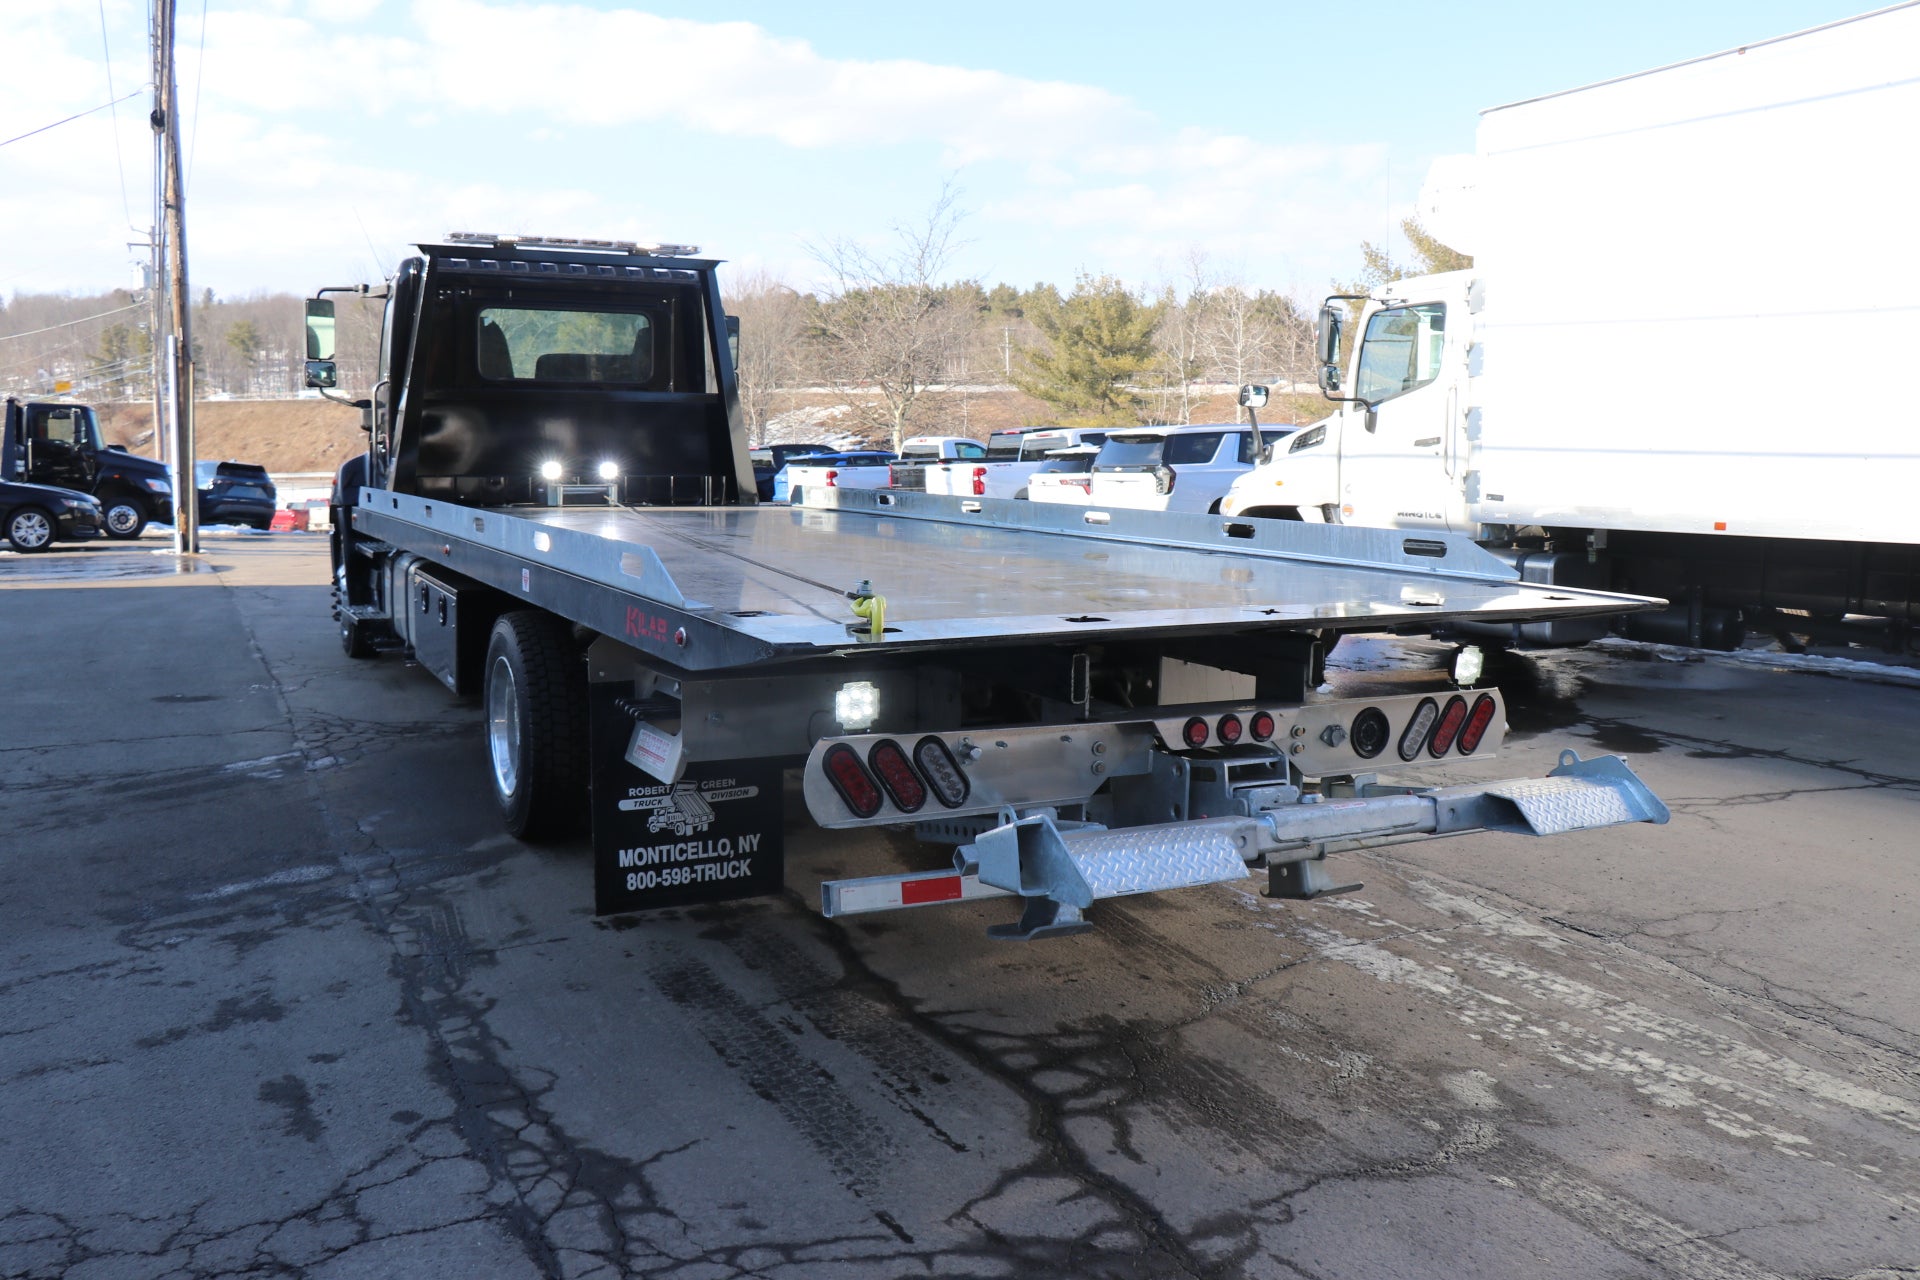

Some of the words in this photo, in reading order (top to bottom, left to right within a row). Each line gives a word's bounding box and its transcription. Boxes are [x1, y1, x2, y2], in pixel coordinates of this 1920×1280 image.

[628, 785, 672, 797] ROBERT
[701, 778, 736, 790] GREEN
[633, 798, 664, 808] TRUCK
[710, 788, 750, 800] DIVISION
[618, 838, 735, 868] MONTICELLO,
[738, 833, 761, 854] NY
[626, 858, 752, 891] 800-598-TRUCK
